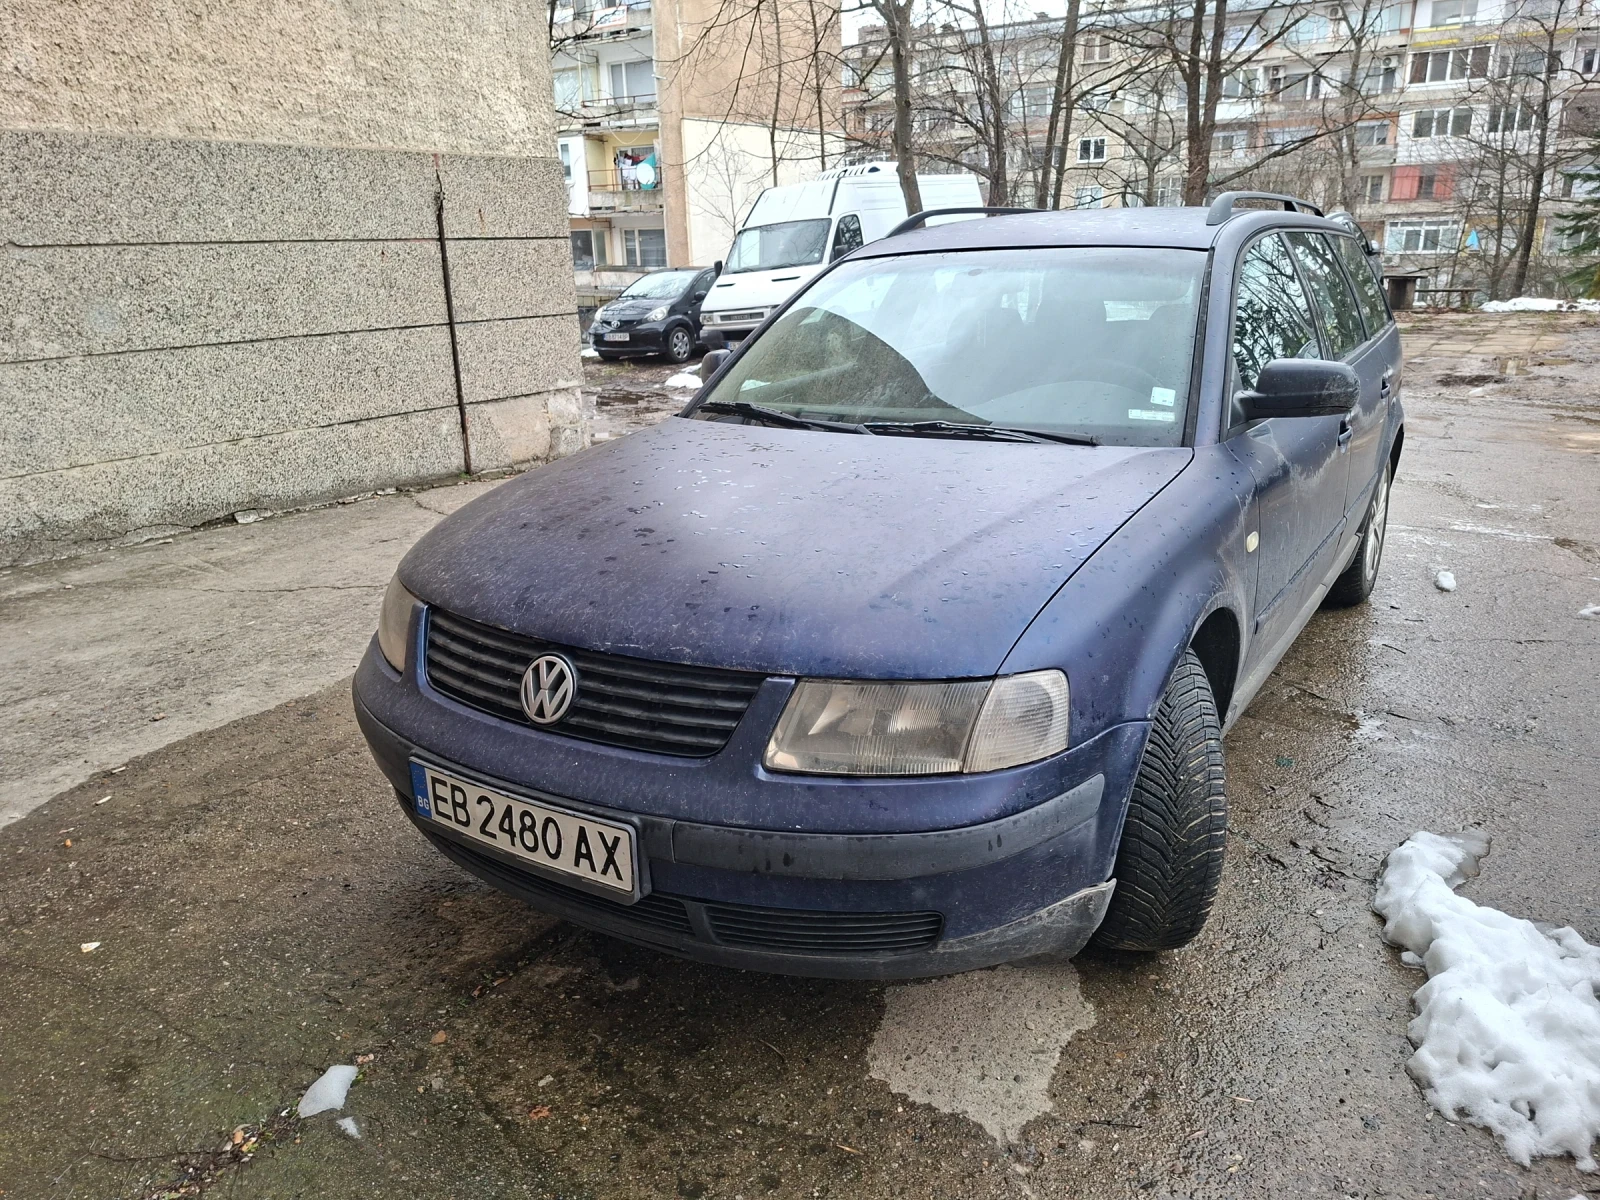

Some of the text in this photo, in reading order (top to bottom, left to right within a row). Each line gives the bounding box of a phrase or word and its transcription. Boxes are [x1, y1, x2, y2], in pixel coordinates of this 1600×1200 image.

[417, 795, 430, 810] BG
[430, 775, 624, 881] EB 2480 AX
